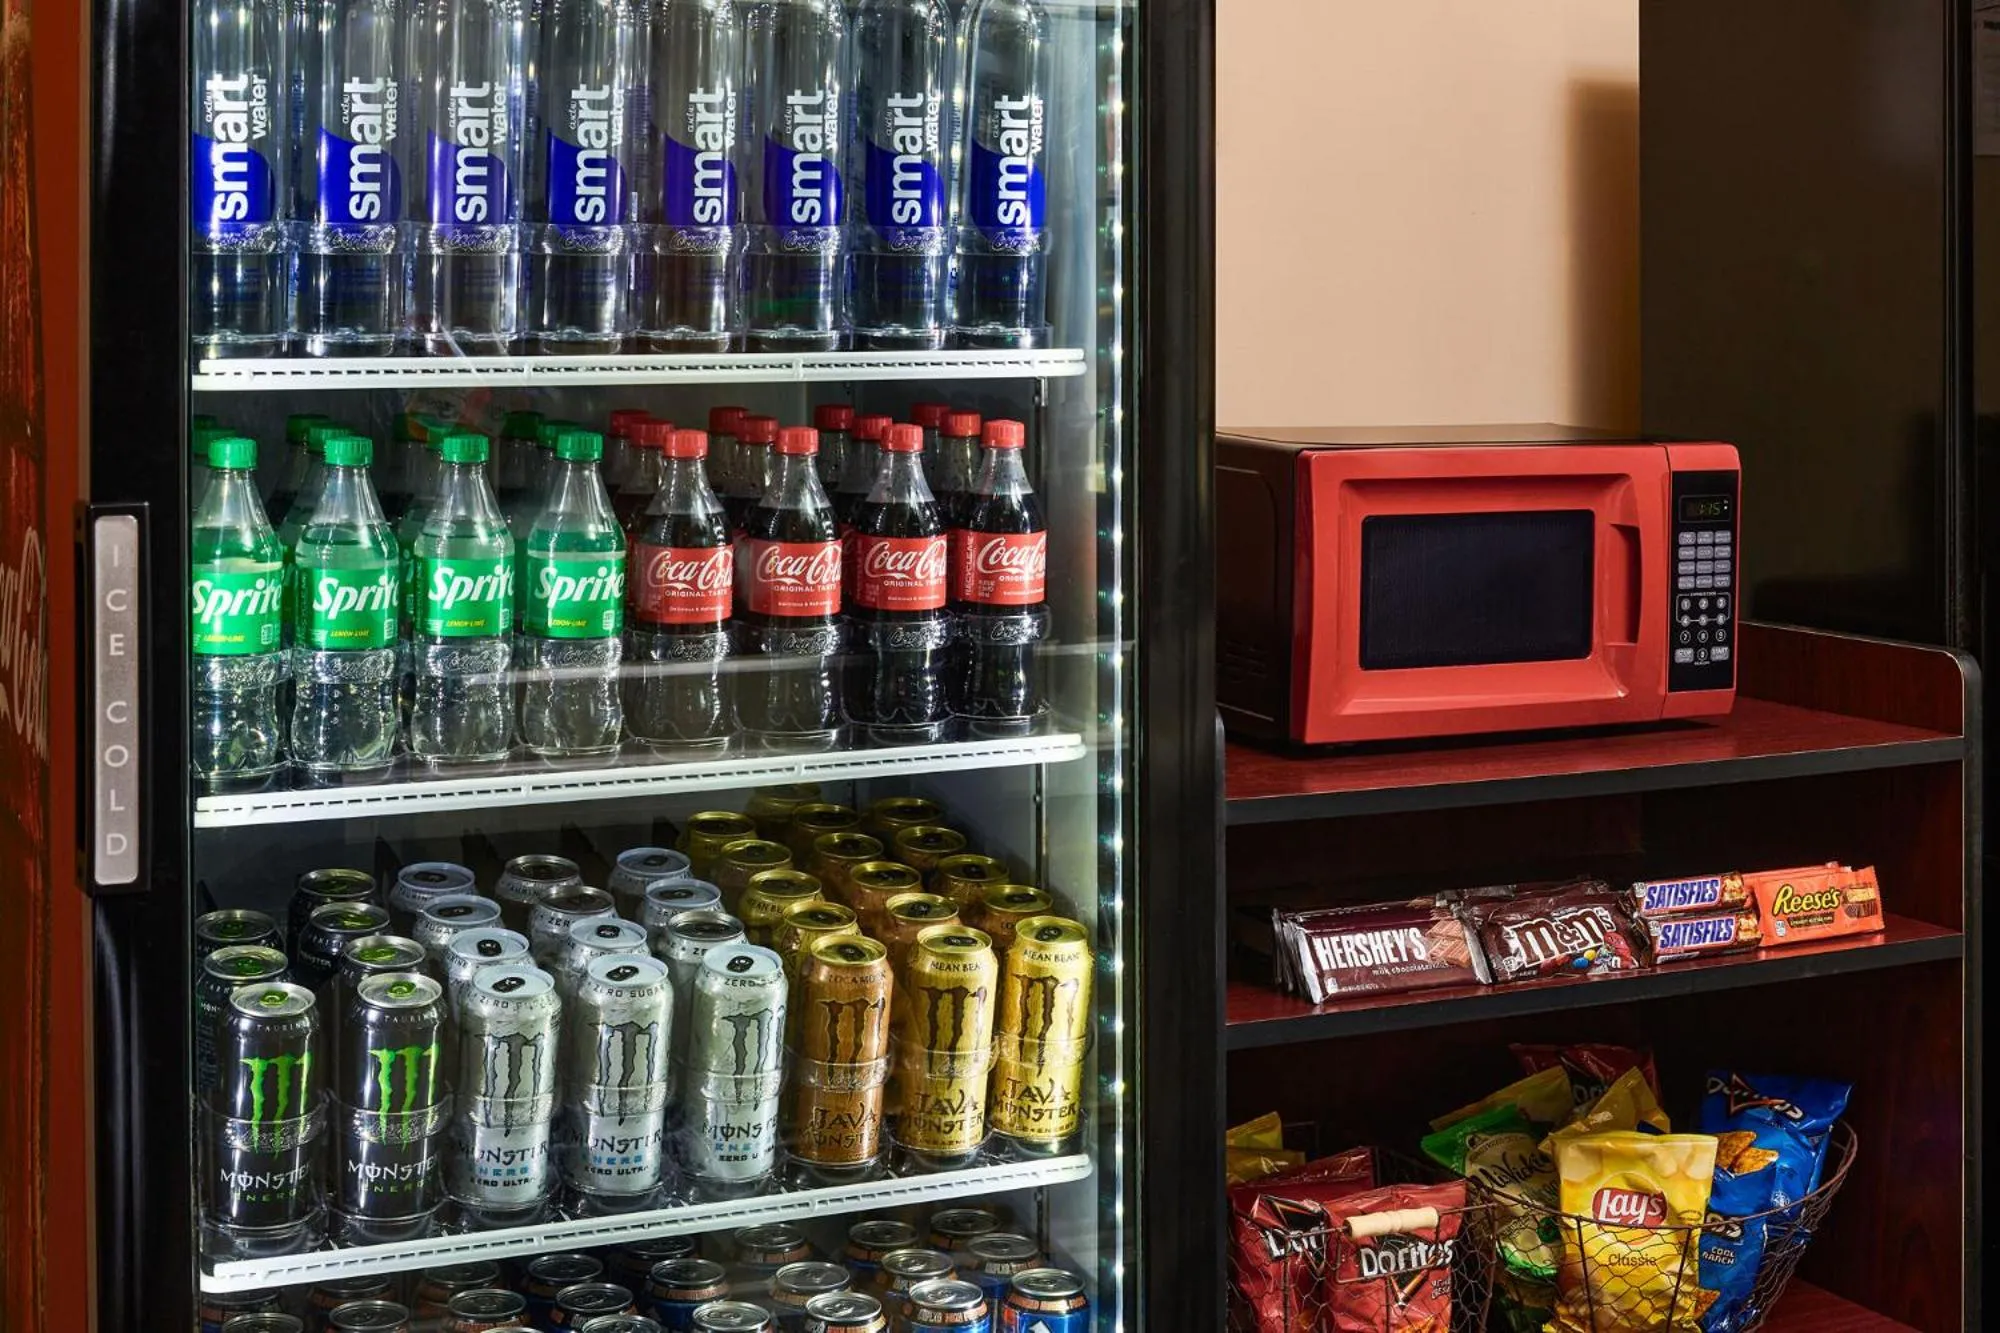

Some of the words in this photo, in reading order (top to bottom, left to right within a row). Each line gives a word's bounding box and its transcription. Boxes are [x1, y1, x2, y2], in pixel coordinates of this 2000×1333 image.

[252, 74, 267, 139] water
[384, 77, 398, 141] water
[491, 82, 507, 144] water
[610, 87, 624, 146] water
[725, 91, 737, 147] water
[824, 91, 839, 150] water
[924, 94, 940, 151] water
[1030, 99, 1043, 155] water
[206, 70, 248, 220] smart
[344, 77, 384, 220] smart
[451, 81, 490, 222] smart
[571, 84, 610, 222] smart
[689, 88, 725, 224] smart
[787, 89, 824, 223] smart
[887, 92, 924, 224] smart
[994, 95, 1029, 225] smart
[105, 544, 128, 656] ICE
[534, 566, 624, 609] Sprite
[664, 589, 706, 598] ORIGINAL
[883, 579, 924, 587] ORIGINAL
[104, 701, 129, 856] COLD
[1644, 879, 1720, 910] SATISFIES
[1772, 882, 1841, 917] Reese's
[1312, 927, 1427, 970] HERSHEY'S
[1660, 918, 1735, 949] SATISFIES
[724, 978, 756, 988] ZERO
[930, 960, 960, 972] MEAN
[962, 961, 982, 972] BEA
[1371, 967, 1391, 976] milk
[911, 1088, 979, 1117] JAVA
[996, 1101, 1077, 1122] MONSTER
[1001, 1077, 1072, 1106] JAVA
[813, 1101, 877, 1130] JAVA
[220, 1164, 308, 1191] MONSTE
[348, 1155, 435, 1182] MONSTE
[718, 1153, 748, 1163] ZERO
[1598, 1189, 1663, 1225] Lay's
[1360, 1239, 1453, 1278] Doritos
[1607, 1252, 1657, 1267] Classic
[1702, 1251, 1736, 1265] RANCH
[1711, 1246, 1736, 1258] COOL
